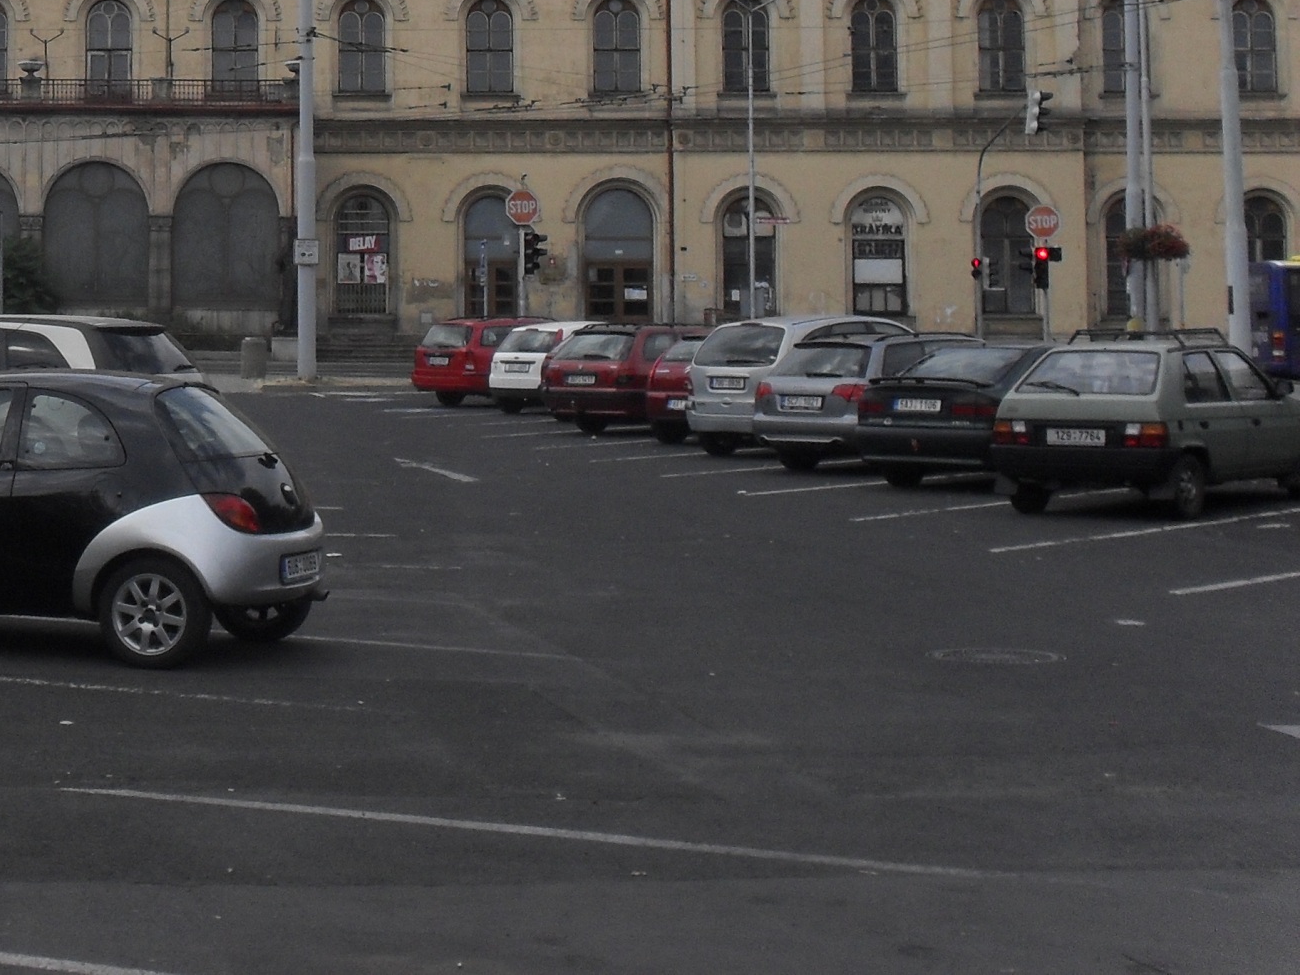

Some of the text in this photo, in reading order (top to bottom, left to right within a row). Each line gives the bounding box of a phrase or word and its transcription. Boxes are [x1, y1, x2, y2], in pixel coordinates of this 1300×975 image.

[510, 200, 536, 214] STOP
[1029, 215, 1057, 229] STOP
[349, 235, 376, 251] RELAY
